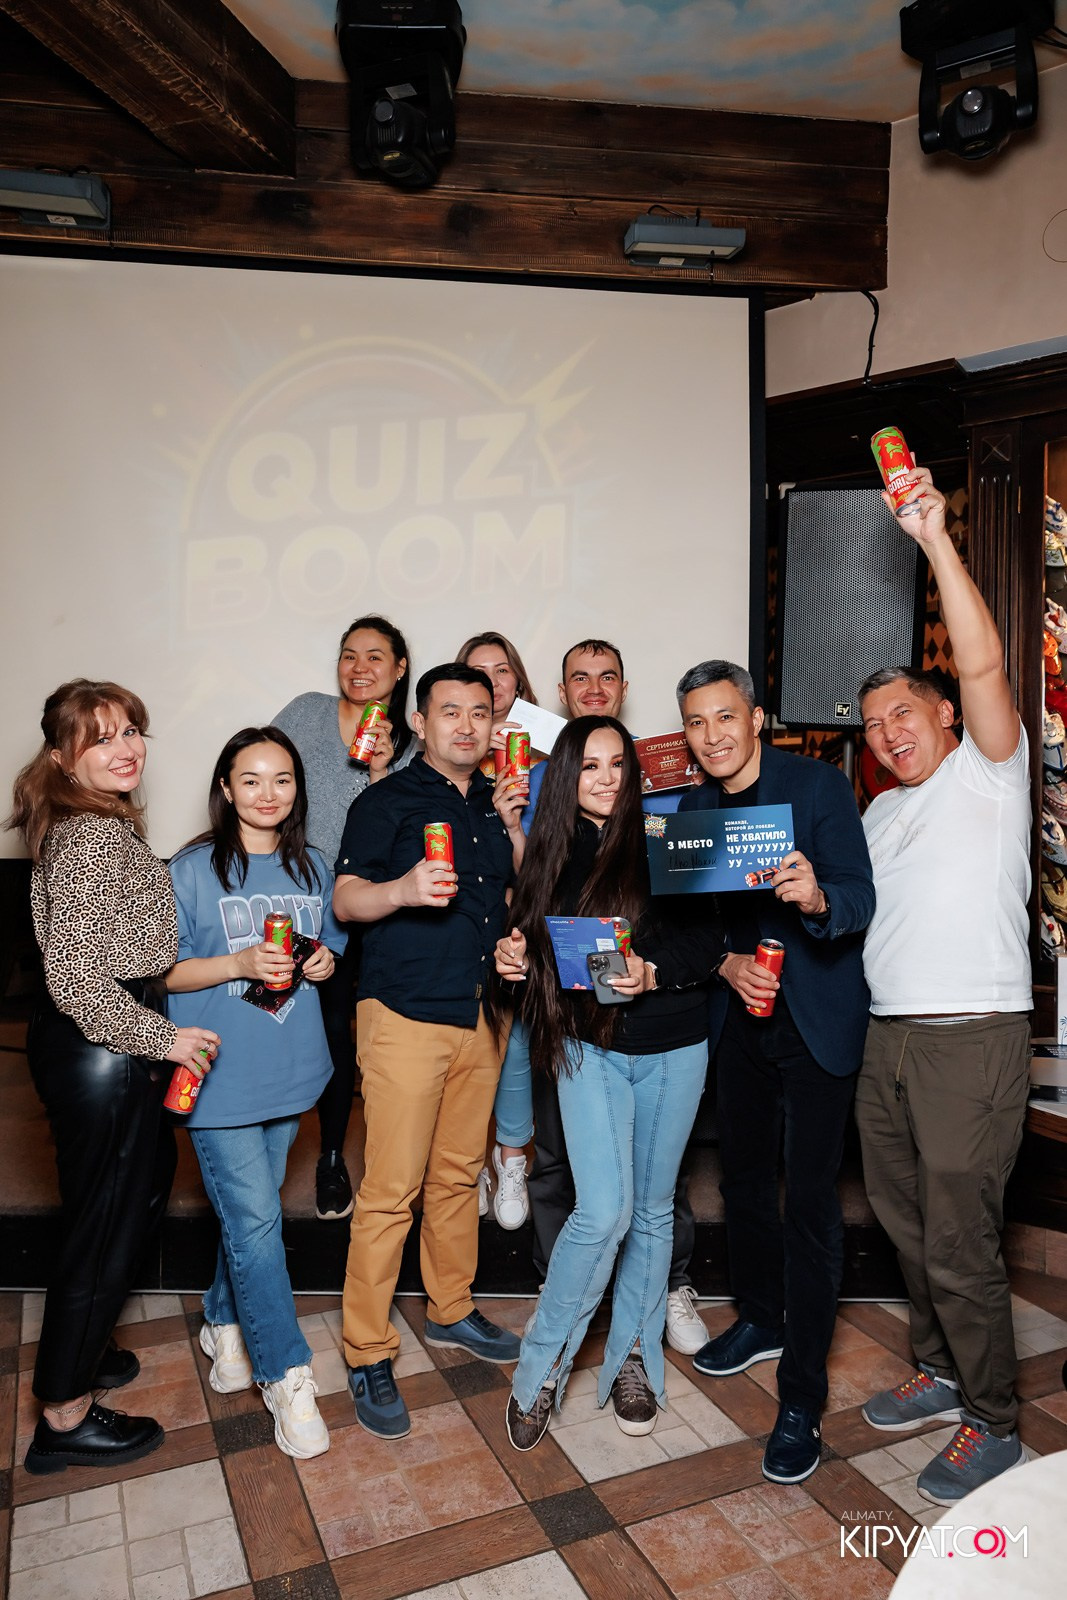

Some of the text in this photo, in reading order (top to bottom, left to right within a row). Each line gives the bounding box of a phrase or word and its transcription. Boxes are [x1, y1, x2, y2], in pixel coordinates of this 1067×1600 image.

[227, 411, 528, 522] QUIZ
[888, 476, 919, 495] GORI
[185, 503, 566, 631] BOOM
[646, 738, 687, 751] СЕРТИФИКАТ
[667, 838, 714, 850] 3 МЕСТО
[726, 830, 787, 843] НЕ ХВАТИЛО
